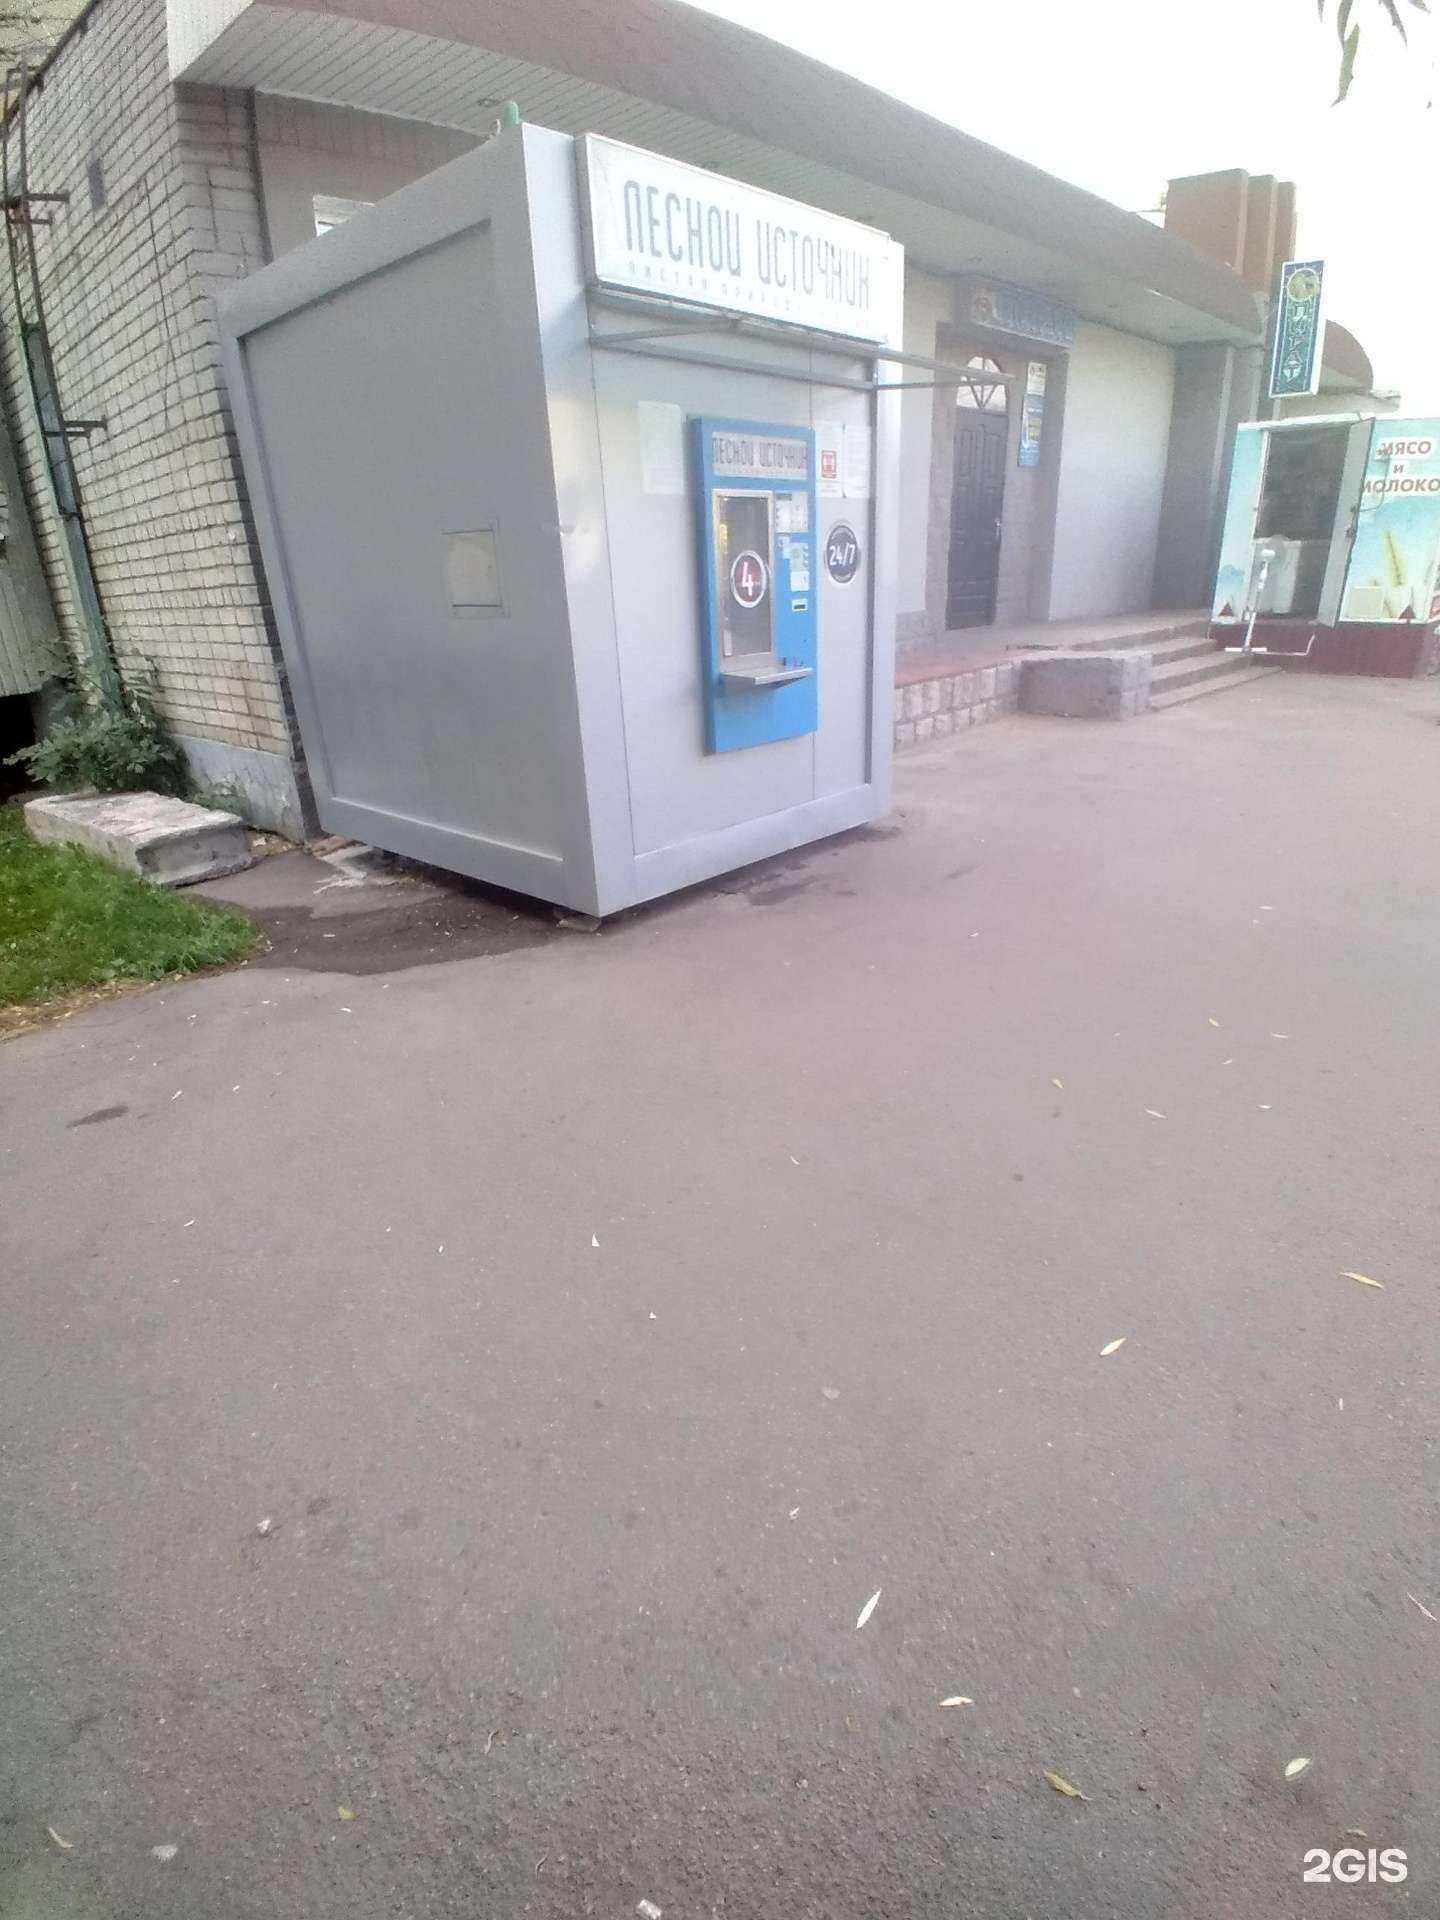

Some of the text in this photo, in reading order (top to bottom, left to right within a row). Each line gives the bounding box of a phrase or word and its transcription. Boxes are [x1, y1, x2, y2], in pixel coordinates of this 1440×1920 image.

[1379, 441, 1432, 455] МЯСО
[829, 542, 856, 567] 24/7
[742, 561, 754, 597] 4
